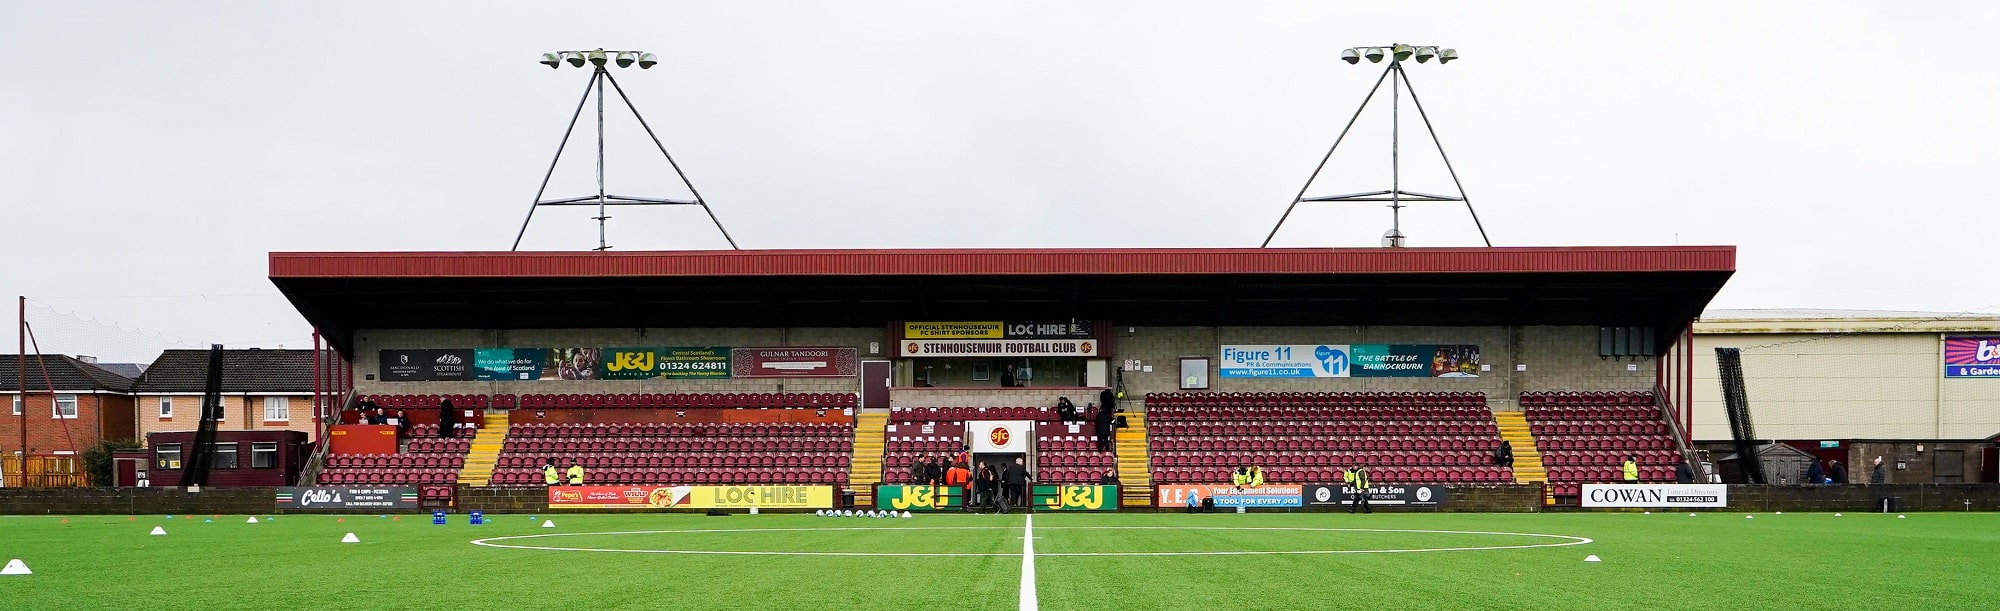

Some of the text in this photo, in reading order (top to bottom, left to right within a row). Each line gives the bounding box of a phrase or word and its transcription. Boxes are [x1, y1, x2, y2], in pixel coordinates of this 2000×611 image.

[1008, 324, 1034, 335] LOC
[1036, 324, 1066, 335] HIRE
[923, 342, 1076, 354] STENHOUSEMUIR FOOTBALL CLUB
[1224, 346, 1291, 363] Figure 11
[607, 351, 654, 371] J&J
[1323, 355, 1344, 375] 11
[1960, 367, 2000, 376] & Garde
[991, 426, 1009, 443] sfc
[301, 489, 342, 506] Cello's
[561, 491, 579, 499] Pepe's
[714, 487, 807, 504] LOC HIRE
[1046, 486, 1103, 509] J&J
[1229, 487, 1265, 495] Equipment
[1266, 486, 1299, 494] Solutions
[1379, 486, 1387, 494] &
[1388, 486, 1405, 494] Son
[1590, 489, 1662, 502] COWAN
